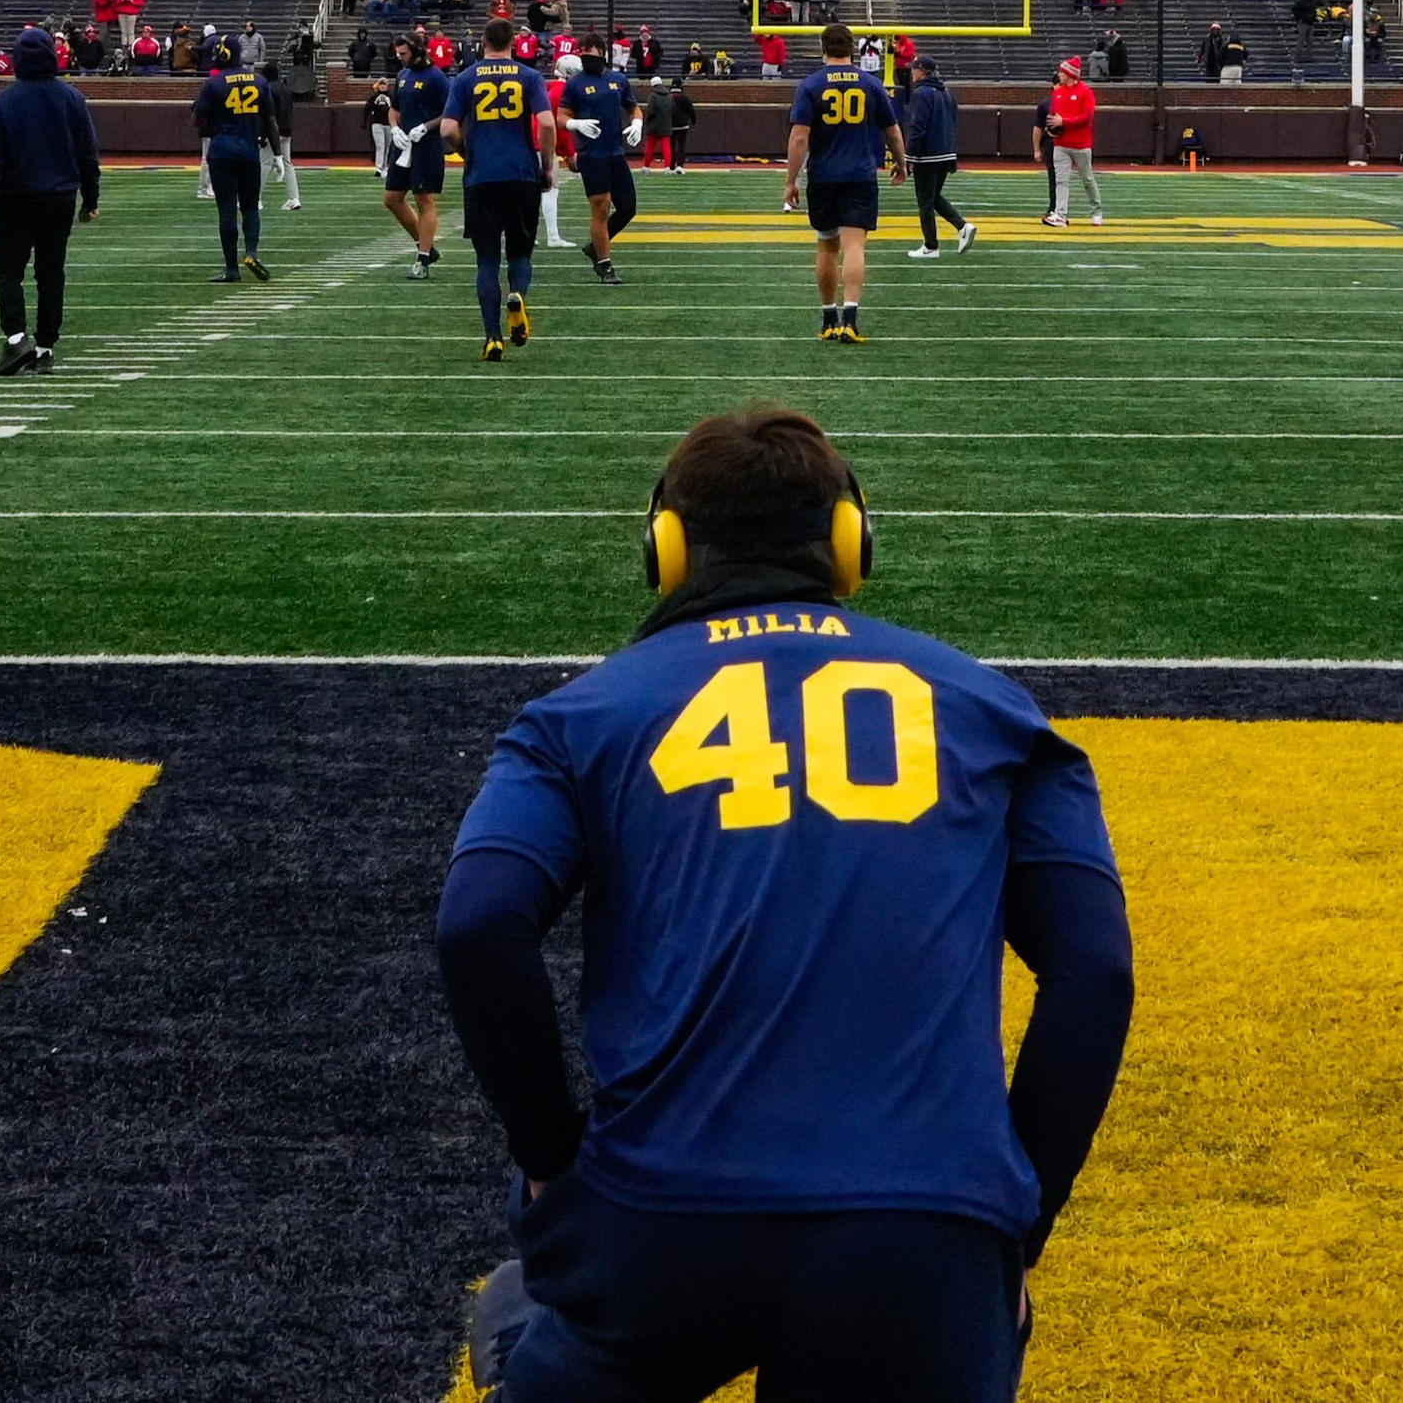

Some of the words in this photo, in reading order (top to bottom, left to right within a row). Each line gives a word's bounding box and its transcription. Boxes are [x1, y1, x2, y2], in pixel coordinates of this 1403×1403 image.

[435, 45, 444, 58] 4
[521, 42, 528, 54] 4
[559, 41, 572, 53] 10
[476, 65, 519, 77] SULLIVAN
[225, 85, 260, 115] 42
[473, 80, 524, 122] 23
[821, 87, 866, 125] 30
[707, 612, 851, 644] MILIA
[649, 659, 940, 831] 40
